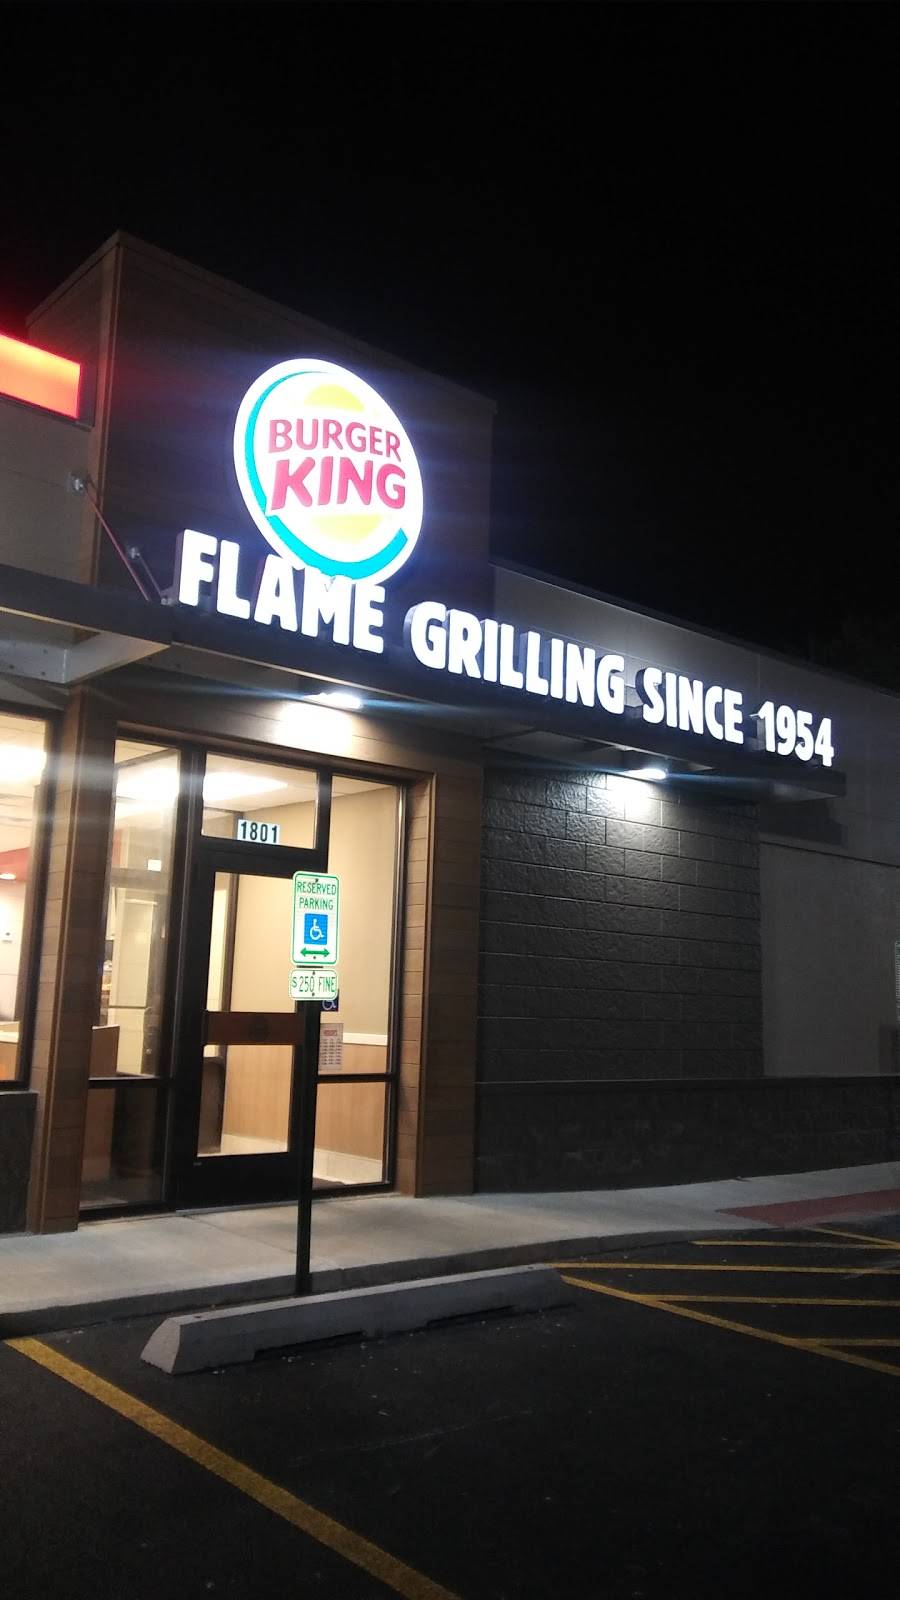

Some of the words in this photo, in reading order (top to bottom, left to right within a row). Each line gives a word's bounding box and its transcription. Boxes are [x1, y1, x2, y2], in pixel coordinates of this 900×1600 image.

[268, 418, 402, 463] BURGER
[271, 456, 406, 511] KING
[177, 529, 385, 654] FLAME
[408, 600, 625, 714] GRILLING
[641, 667, 745, 745] SINCE
[756, 700, 835, 767] 1954
[240, 821, 278, 843] 1801
[296, 881, 337, 896] RESERVED
[299, 897, 334, 911] PARKING
[318, 976, 336, 993] FINE
